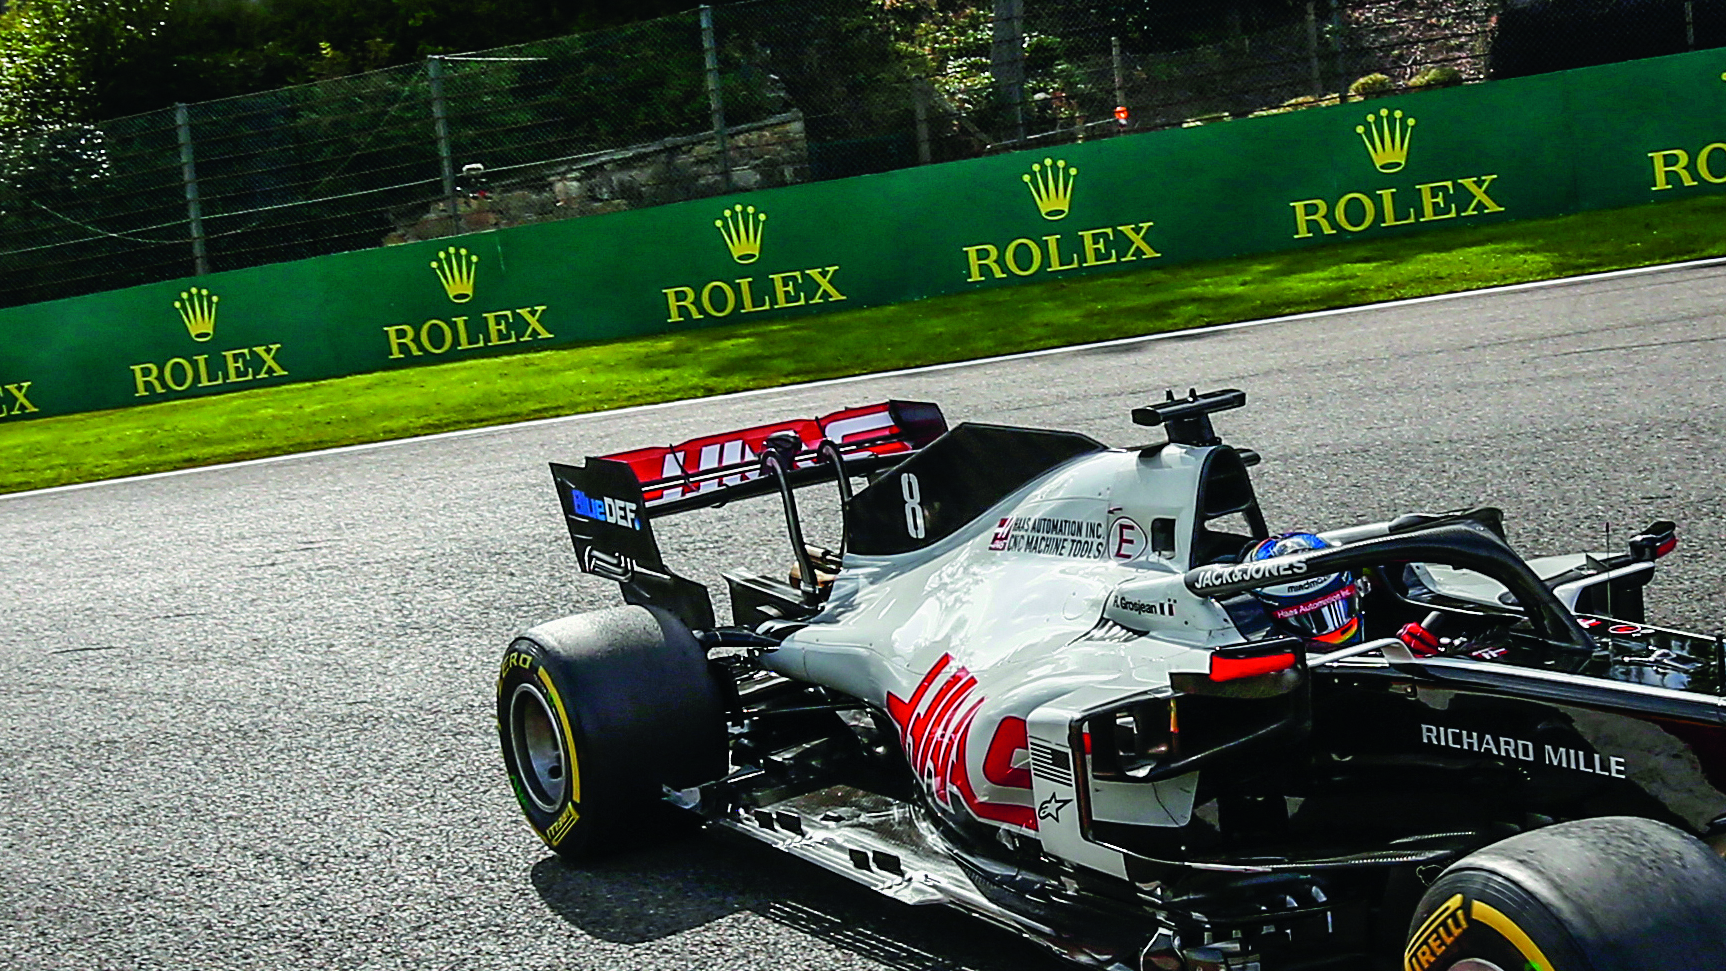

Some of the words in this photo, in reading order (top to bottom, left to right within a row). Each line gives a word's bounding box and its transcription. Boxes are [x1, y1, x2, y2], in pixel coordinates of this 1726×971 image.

[1290, 174, 1505, 238] ROLEX
[963, 221, 1161, 283] ROLEX
[664, 265, 848, 323] ROLEX
[383, 304, 555, 360] ROLEX
[130, 344, 289, 397] ROLEX
[901, 472, 926, 540] 8
[1031, 518, 1083, 537] AUTOMATION
[1085, 521, 1106, 539] INC.
[1007, 533, 1025, 552] CNC
[1024, 534, 1068, 556] MACHINE
[1068, 539, 1104, 559] TOOLS
[1194, 560, 1308, 589] JACK&JONES
[1120, 597, 1158, 615] Grosjean
[1277, 608, 1298, 618] Haas
[1420, 723, 1535, 762] RICHARD
[1544, 744, 1626, 779] MILLE
